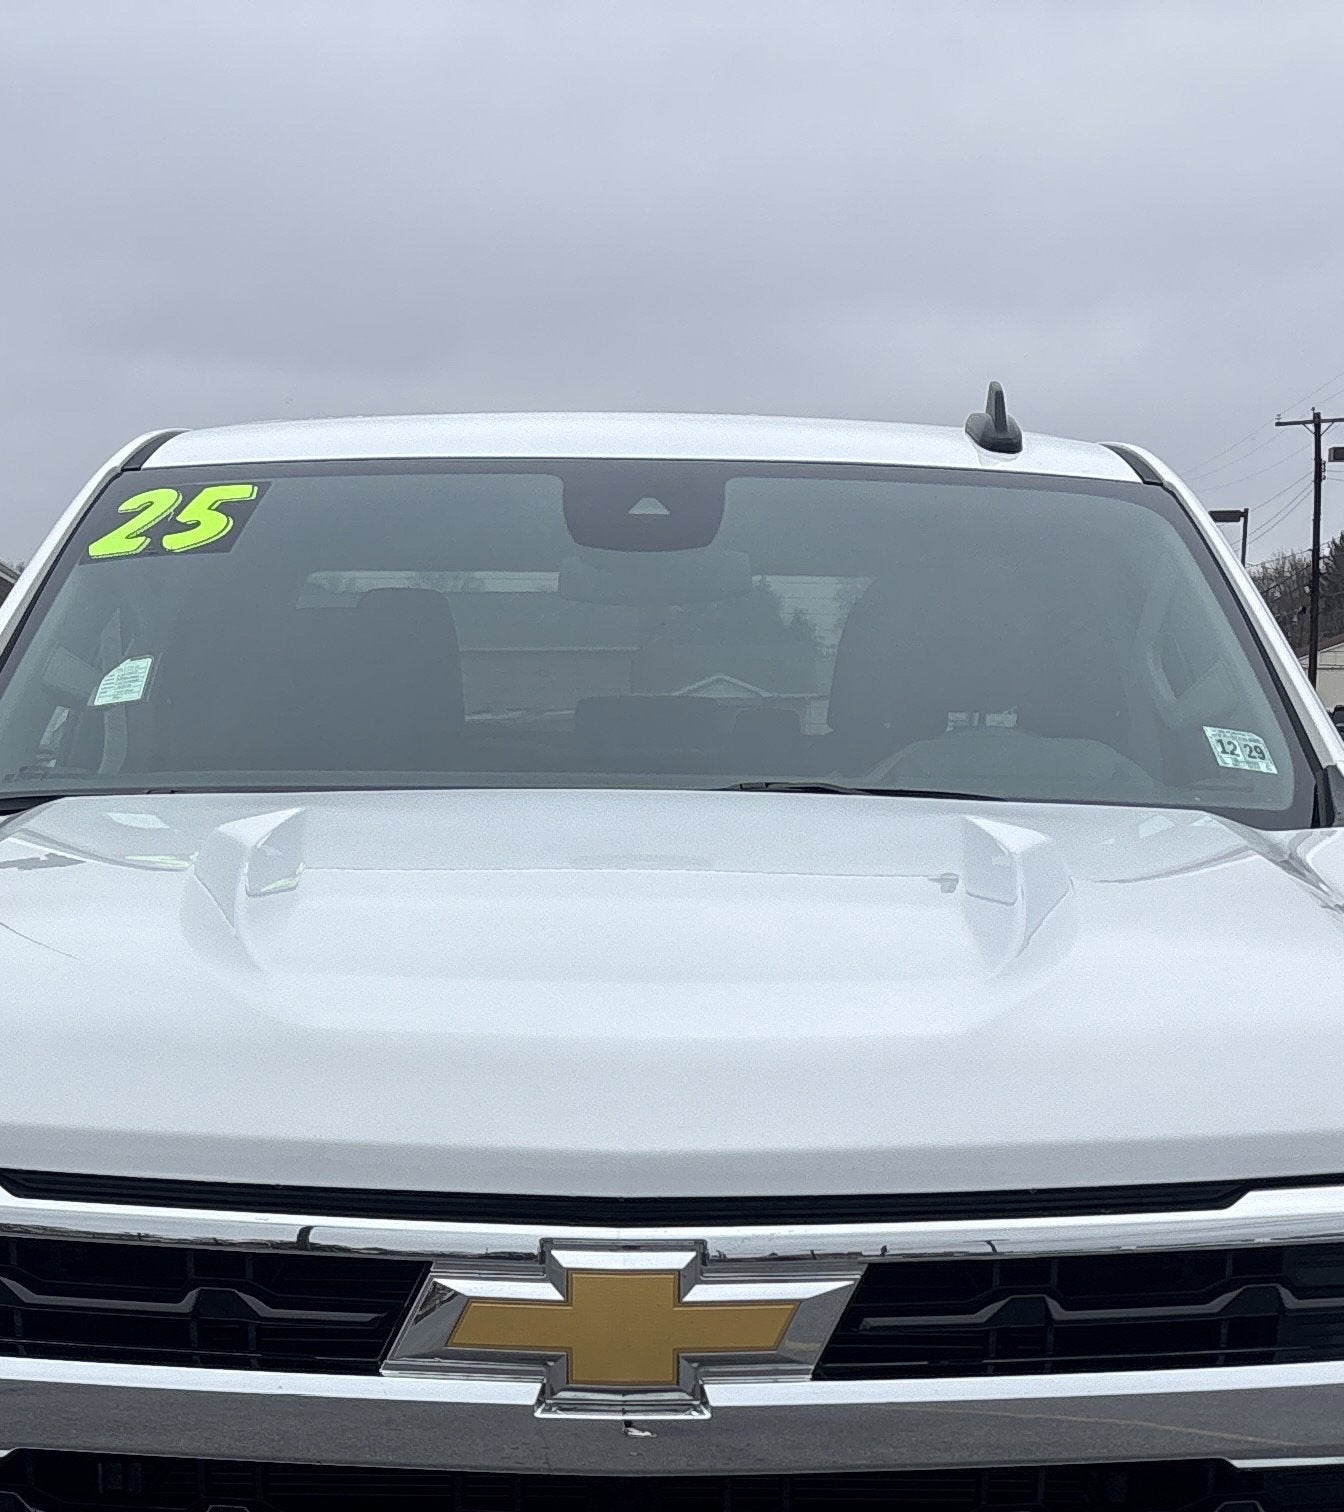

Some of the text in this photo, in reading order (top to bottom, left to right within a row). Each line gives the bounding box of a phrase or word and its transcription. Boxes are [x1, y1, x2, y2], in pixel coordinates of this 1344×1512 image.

[88, 484, 258, 559] 25
[1216, 739, 1266, 760] 12 29
